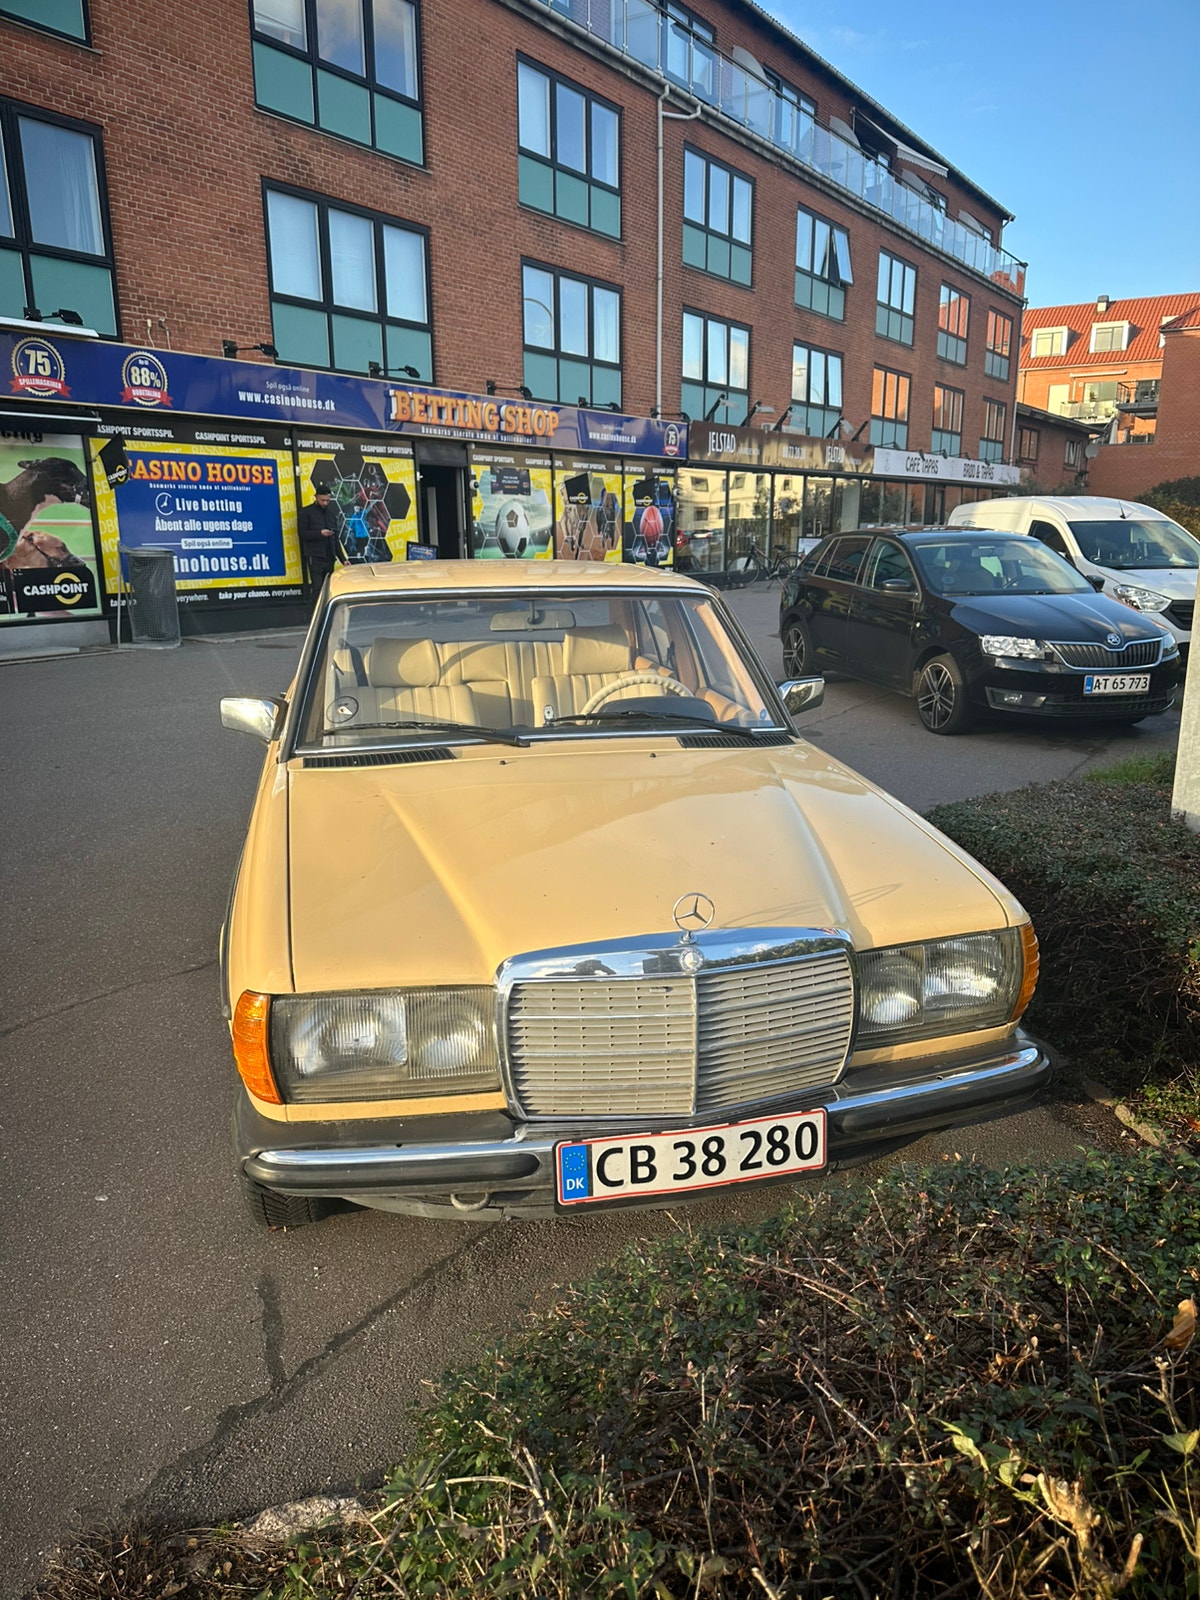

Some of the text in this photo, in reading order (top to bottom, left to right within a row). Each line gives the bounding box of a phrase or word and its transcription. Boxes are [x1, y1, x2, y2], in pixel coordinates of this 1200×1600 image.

[25, 349, 50, 376] 75
[18, 378, 62, 390] SPILLEMASKINER
[130, 367, 161, 388] 88%
[266, 381, 310, 393] Spil også online
[238, 390, 336, 411] www.casinohouse.dk
[389, 389, 560, 437] BETTING SHOP
[133, 427, 174, 438] SPORTSSPIL
[195, 432, 266, 444] CASHPOINT SPORTSSPIL
[668, 431, 676, 445] 75
[314, 441, 345, 451] SPORTSSPIL
[360, 444, 386, 453] CASHPOINT
[708, 431, 736, 456] JELSTAD
[206, 462, 274, 484] HOUSE
[922, 459, 939, 474] TAPAS
[176, 498, 242, 513] Live betting
[155, 516, 253, 532] Åbent alle ugens dage
[184, 540, 195, 548] Spil
[196, 540, 210, 548] også
[173, 554, 270, 573] inohouse.dk
[23, 583, 88, 596] CASHPOINT
[234, 591, 247, 600] your
[248, 590, 270, 598] chance.
[272, 588, 302, 597] everywhere.
[110, 599, 126, 607] tae
[176, 593, 209, 603] verywhere.
[1094, 677, 1148, 690] AT 65 773
[596, 1121, 818, 1187] CB 38 280
[566, 1177, 585, 1191] DK
